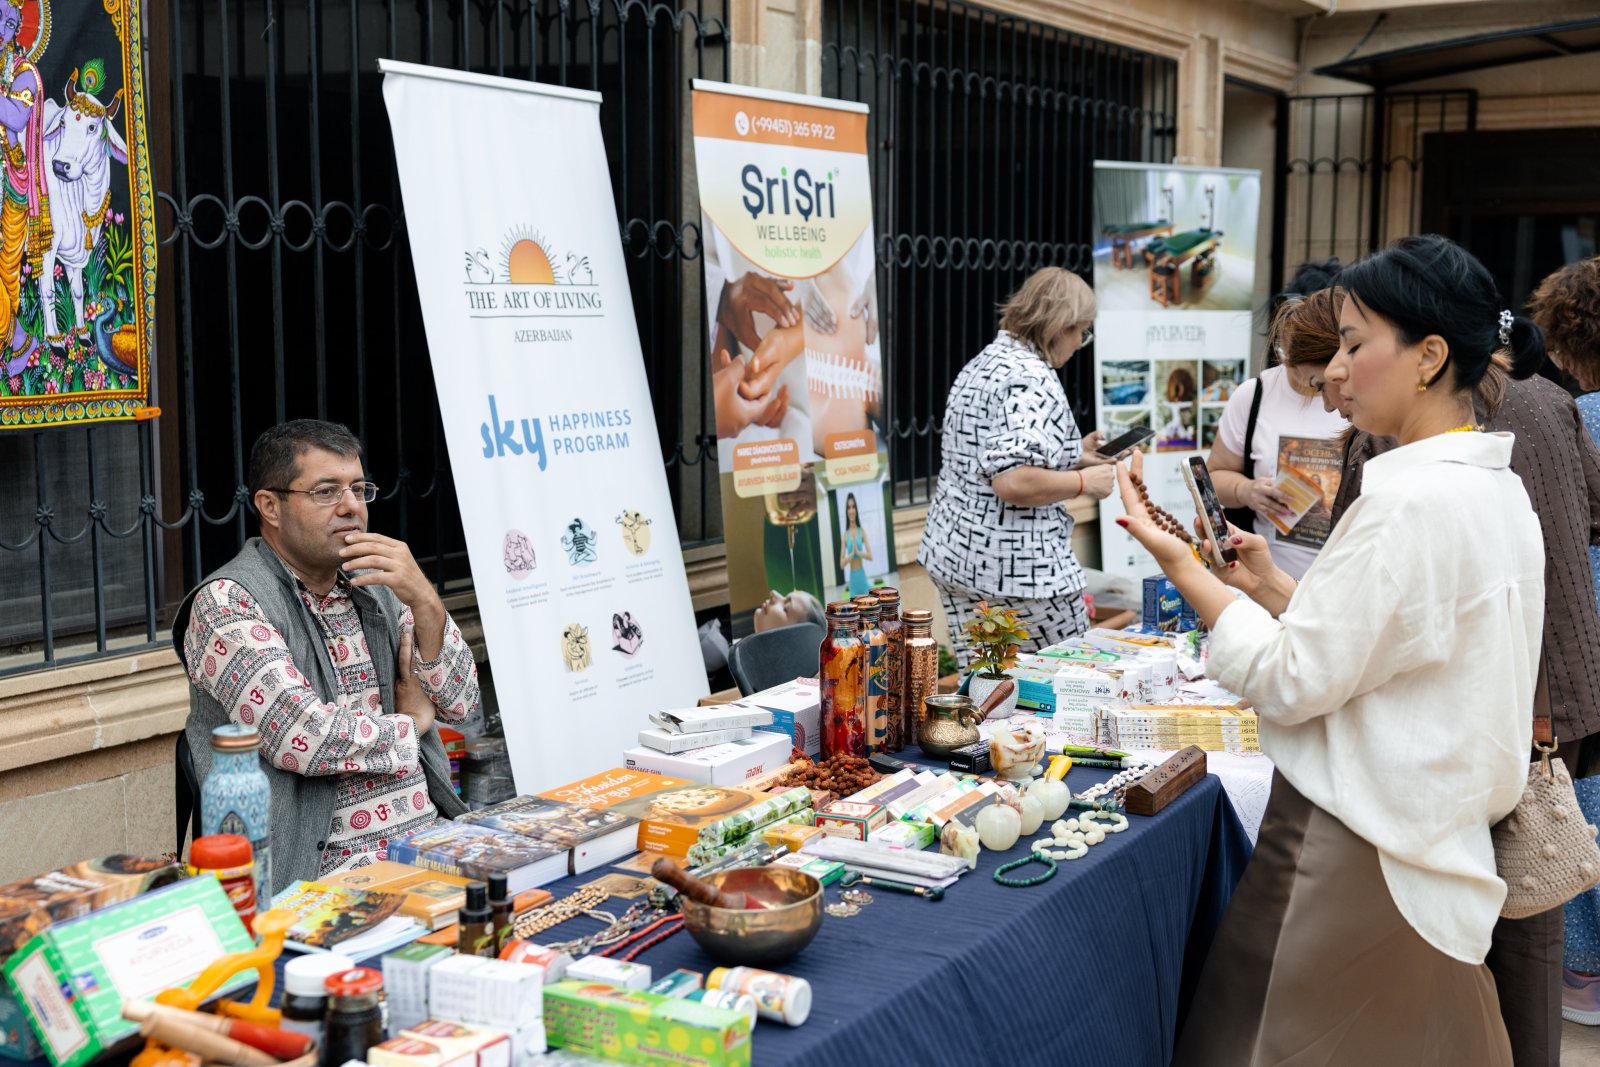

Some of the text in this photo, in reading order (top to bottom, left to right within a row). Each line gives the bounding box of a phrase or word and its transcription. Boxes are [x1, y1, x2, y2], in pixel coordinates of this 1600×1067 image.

[751, 115, 836, 141] (+99451) 365 99 22
[756, 225, 827, 243] WELLBEING
[764, 246, 823, 260] holistic health
[465, 290, 603, 310] THE ART OF LIVING
[513, 328, 573, 343] AZERBAIJAN
[548, 409, 632, 433] HAPPINESS
[480, 394, 548, 472] sky
[552, 431, 631, 456] PROGRAM
[1059, 687, 1090, 695] MADHUKARI
[1062, 706, 1093, 714] MADHUKARI
[1059, 725, 1089, 733] MADHUKARI
